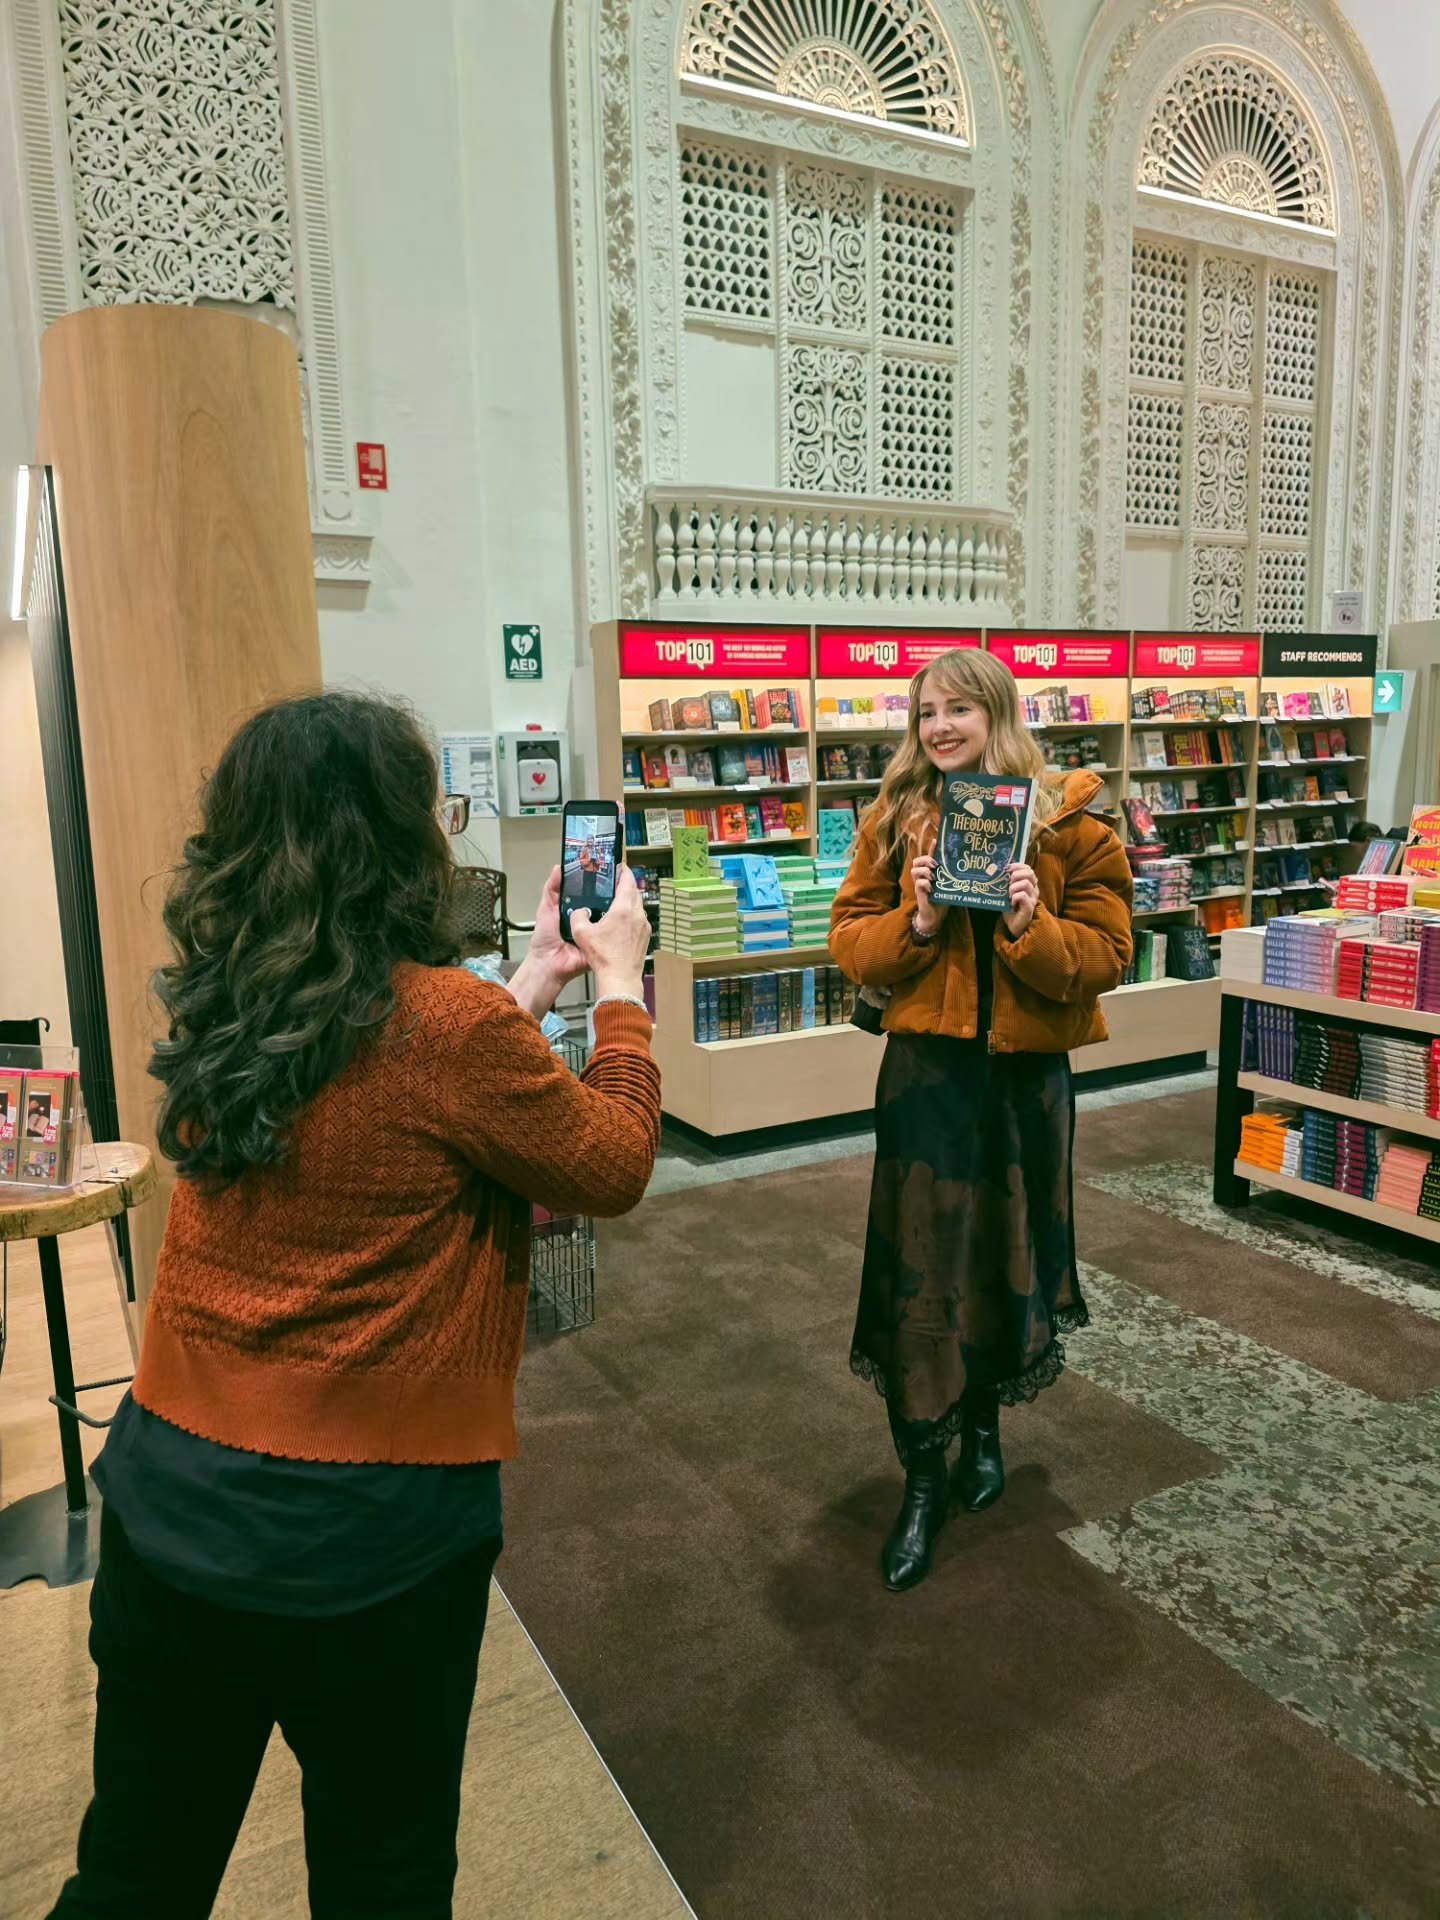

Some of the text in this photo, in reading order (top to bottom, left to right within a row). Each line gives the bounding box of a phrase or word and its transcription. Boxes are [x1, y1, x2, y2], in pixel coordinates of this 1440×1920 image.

[656, 640, 712, 661] TOP 101
[848, 643, 896, 662] TOP 101
[1013, 645, 1036, 663] TOP
[1037, 647, 1055, 663] 101
[1157, 647, 1194, 665] TOP 101
[1281, 651, 1363, 662] STAFF RECOMMENDS
[510, 658, 538, 671] AED
[949, 812, 1014, 836] THEODORA'S
[965, 832, 997, 855] TEA
[957, 851, 991, 871] SHOP
[934, 892, 1005, 907] CHRISTY ANNE JONES
